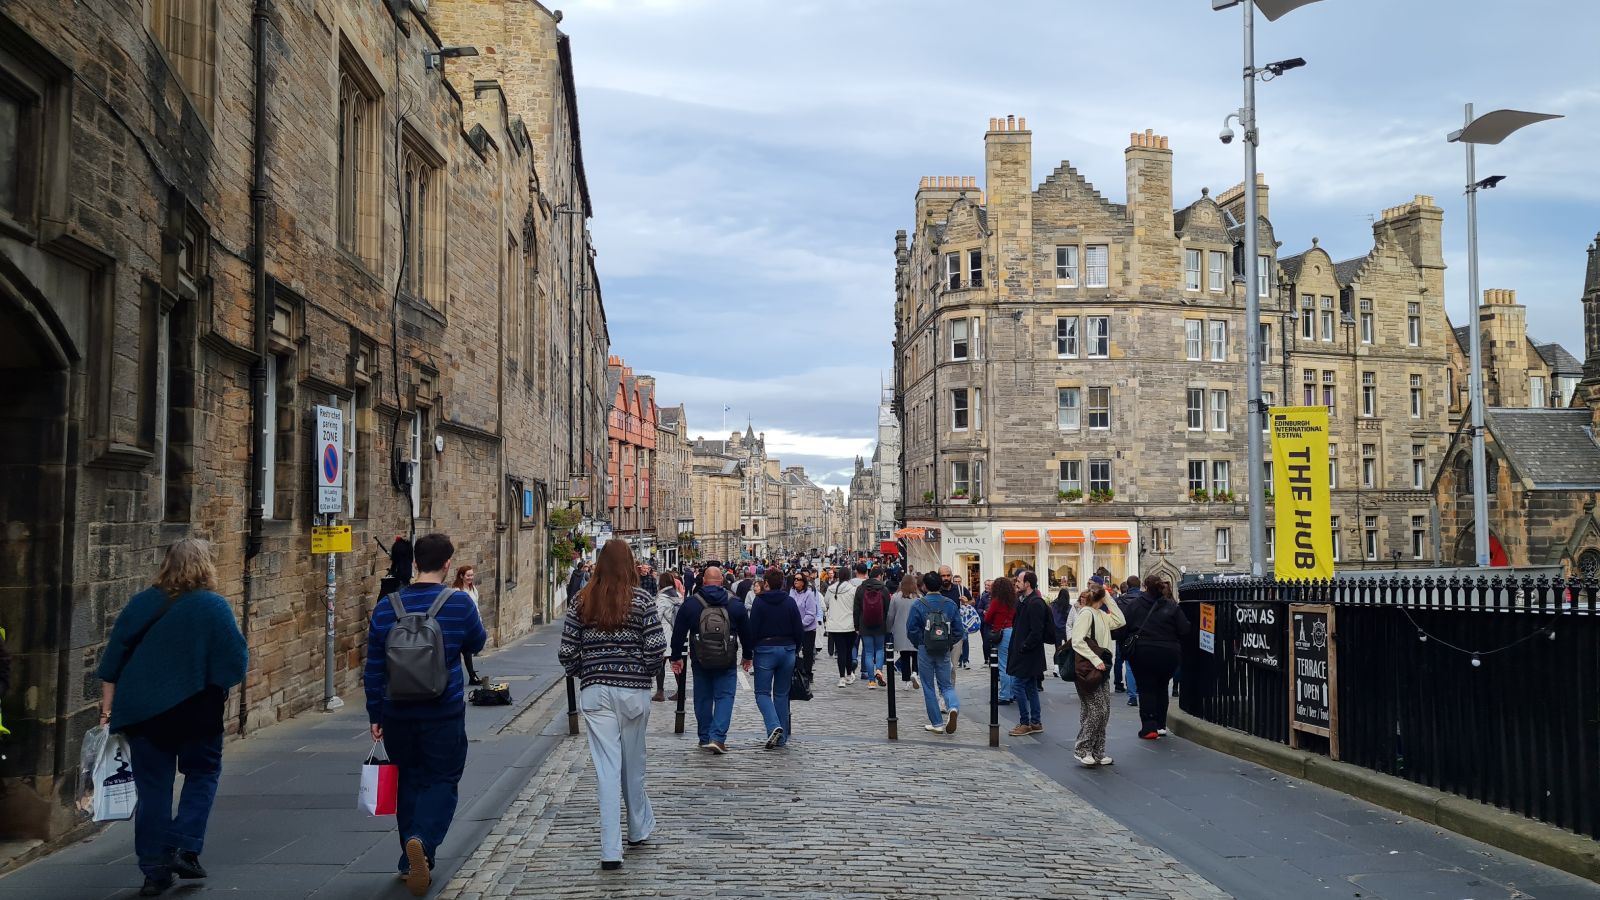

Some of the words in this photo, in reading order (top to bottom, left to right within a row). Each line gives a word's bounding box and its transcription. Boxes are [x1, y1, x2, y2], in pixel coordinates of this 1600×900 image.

[319, 408, 341, 421] Restricted
[322, 421, 338, 431] parking
[322, 430, 338, 442] ZONE
[1288, 446, 1312, 502] THE
[928, 530, 935, 539] K
[947, 537, 987, 545] KILTANE
[1294, 509, 1316, 570] HUB
[1236, 608, 1258, 624] OPEN
[1259, 609, 1275, 625] AS
[1242, 632, 1271, 650] USUAL
[1296, 657, 1327, 680] TERRACE
[1303, 682, 1319, 701] OPEN
